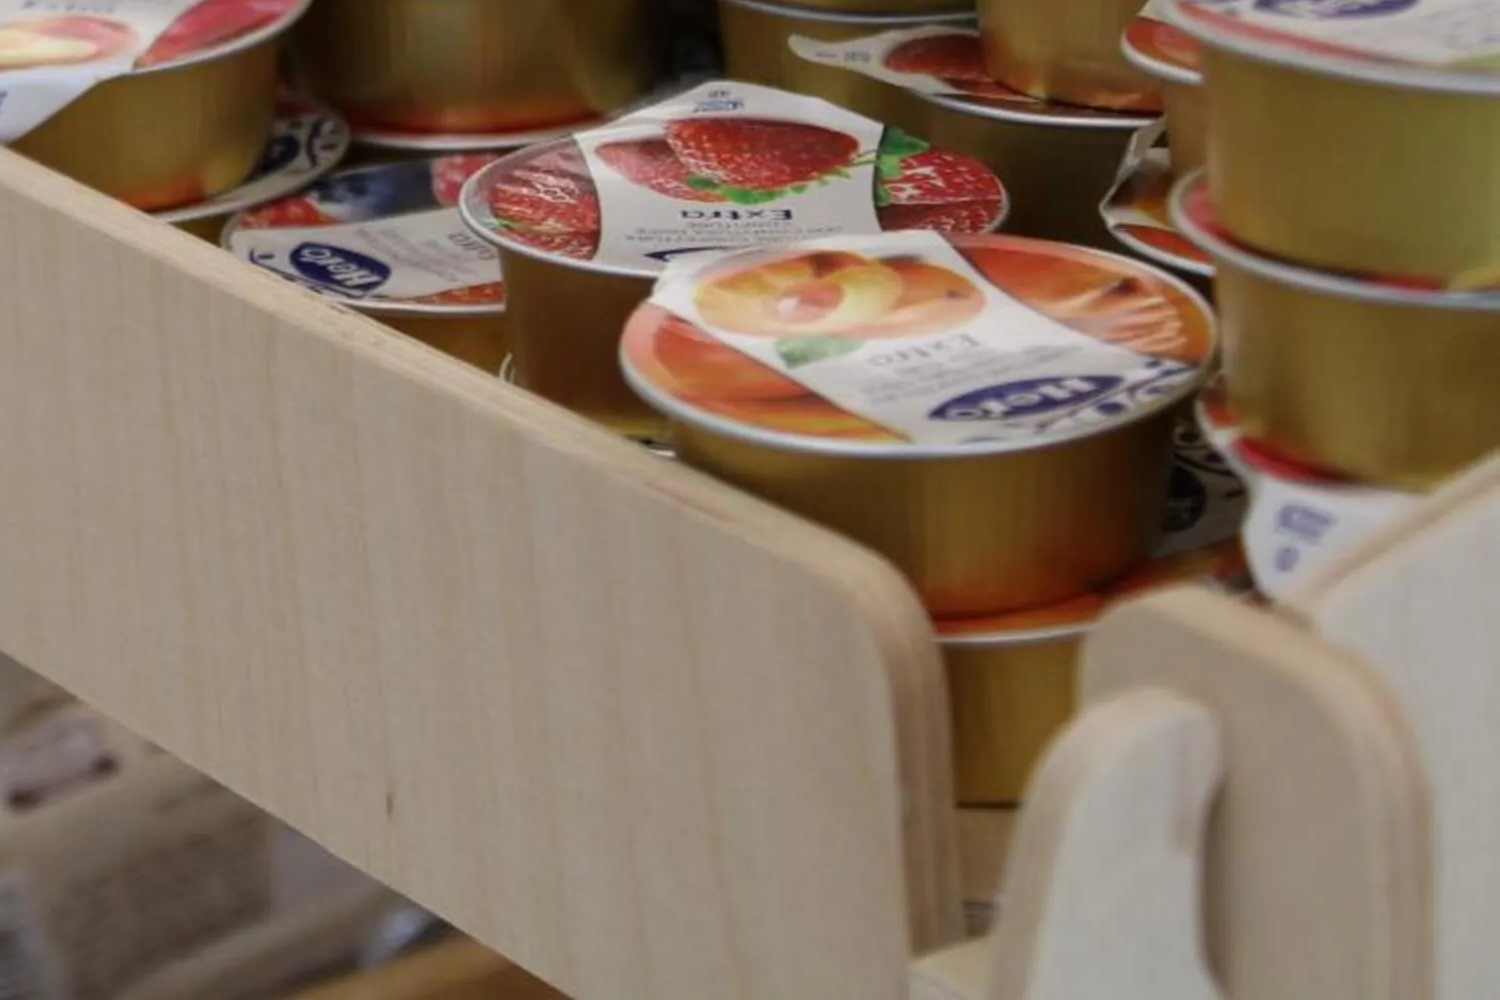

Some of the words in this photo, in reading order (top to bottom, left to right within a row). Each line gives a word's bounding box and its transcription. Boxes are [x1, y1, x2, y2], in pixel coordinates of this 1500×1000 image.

[680, 208, 794, 221] Extra
[299, 246, 385, 288] Hero
[943, 376, 1097, 420] Hero
